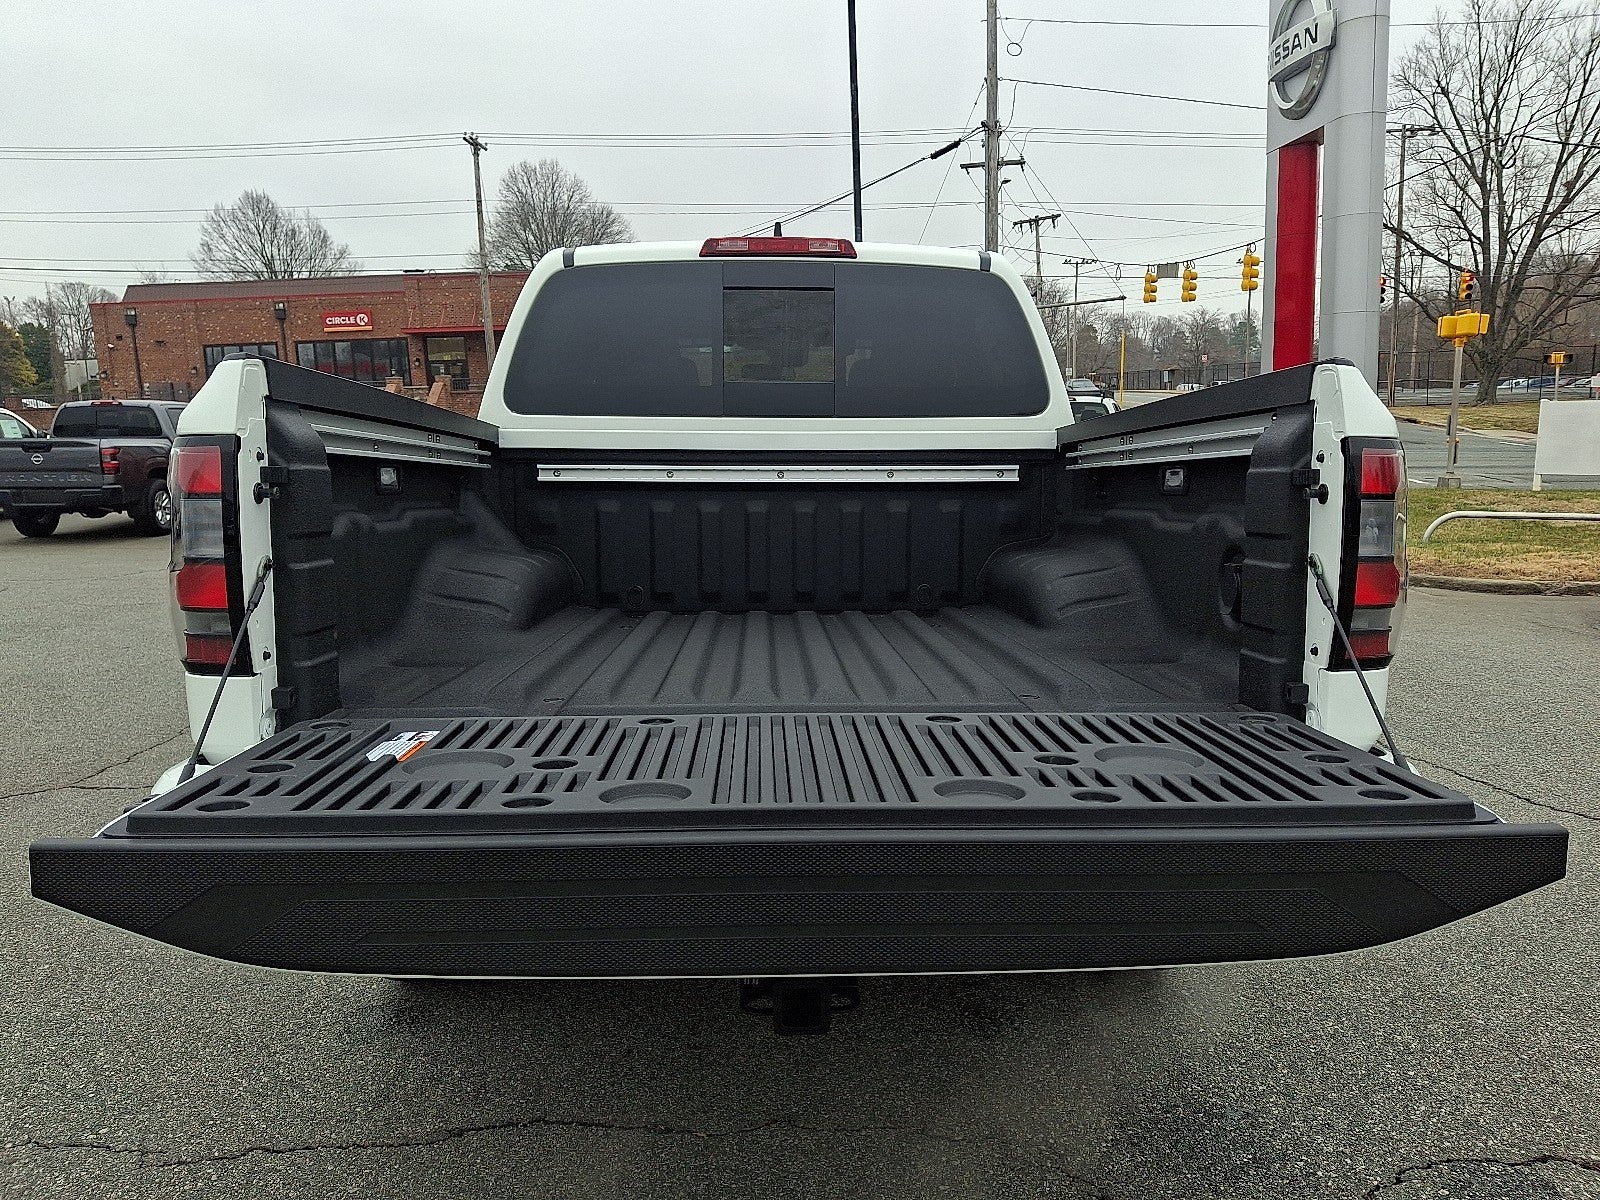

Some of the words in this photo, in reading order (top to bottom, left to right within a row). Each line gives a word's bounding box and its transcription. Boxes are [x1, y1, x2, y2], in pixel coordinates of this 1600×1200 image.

[325, 316, 356, 325] CIRCLE
[358, 315, 368, 325] K
[0, 474, 92, 482] RONTIER
